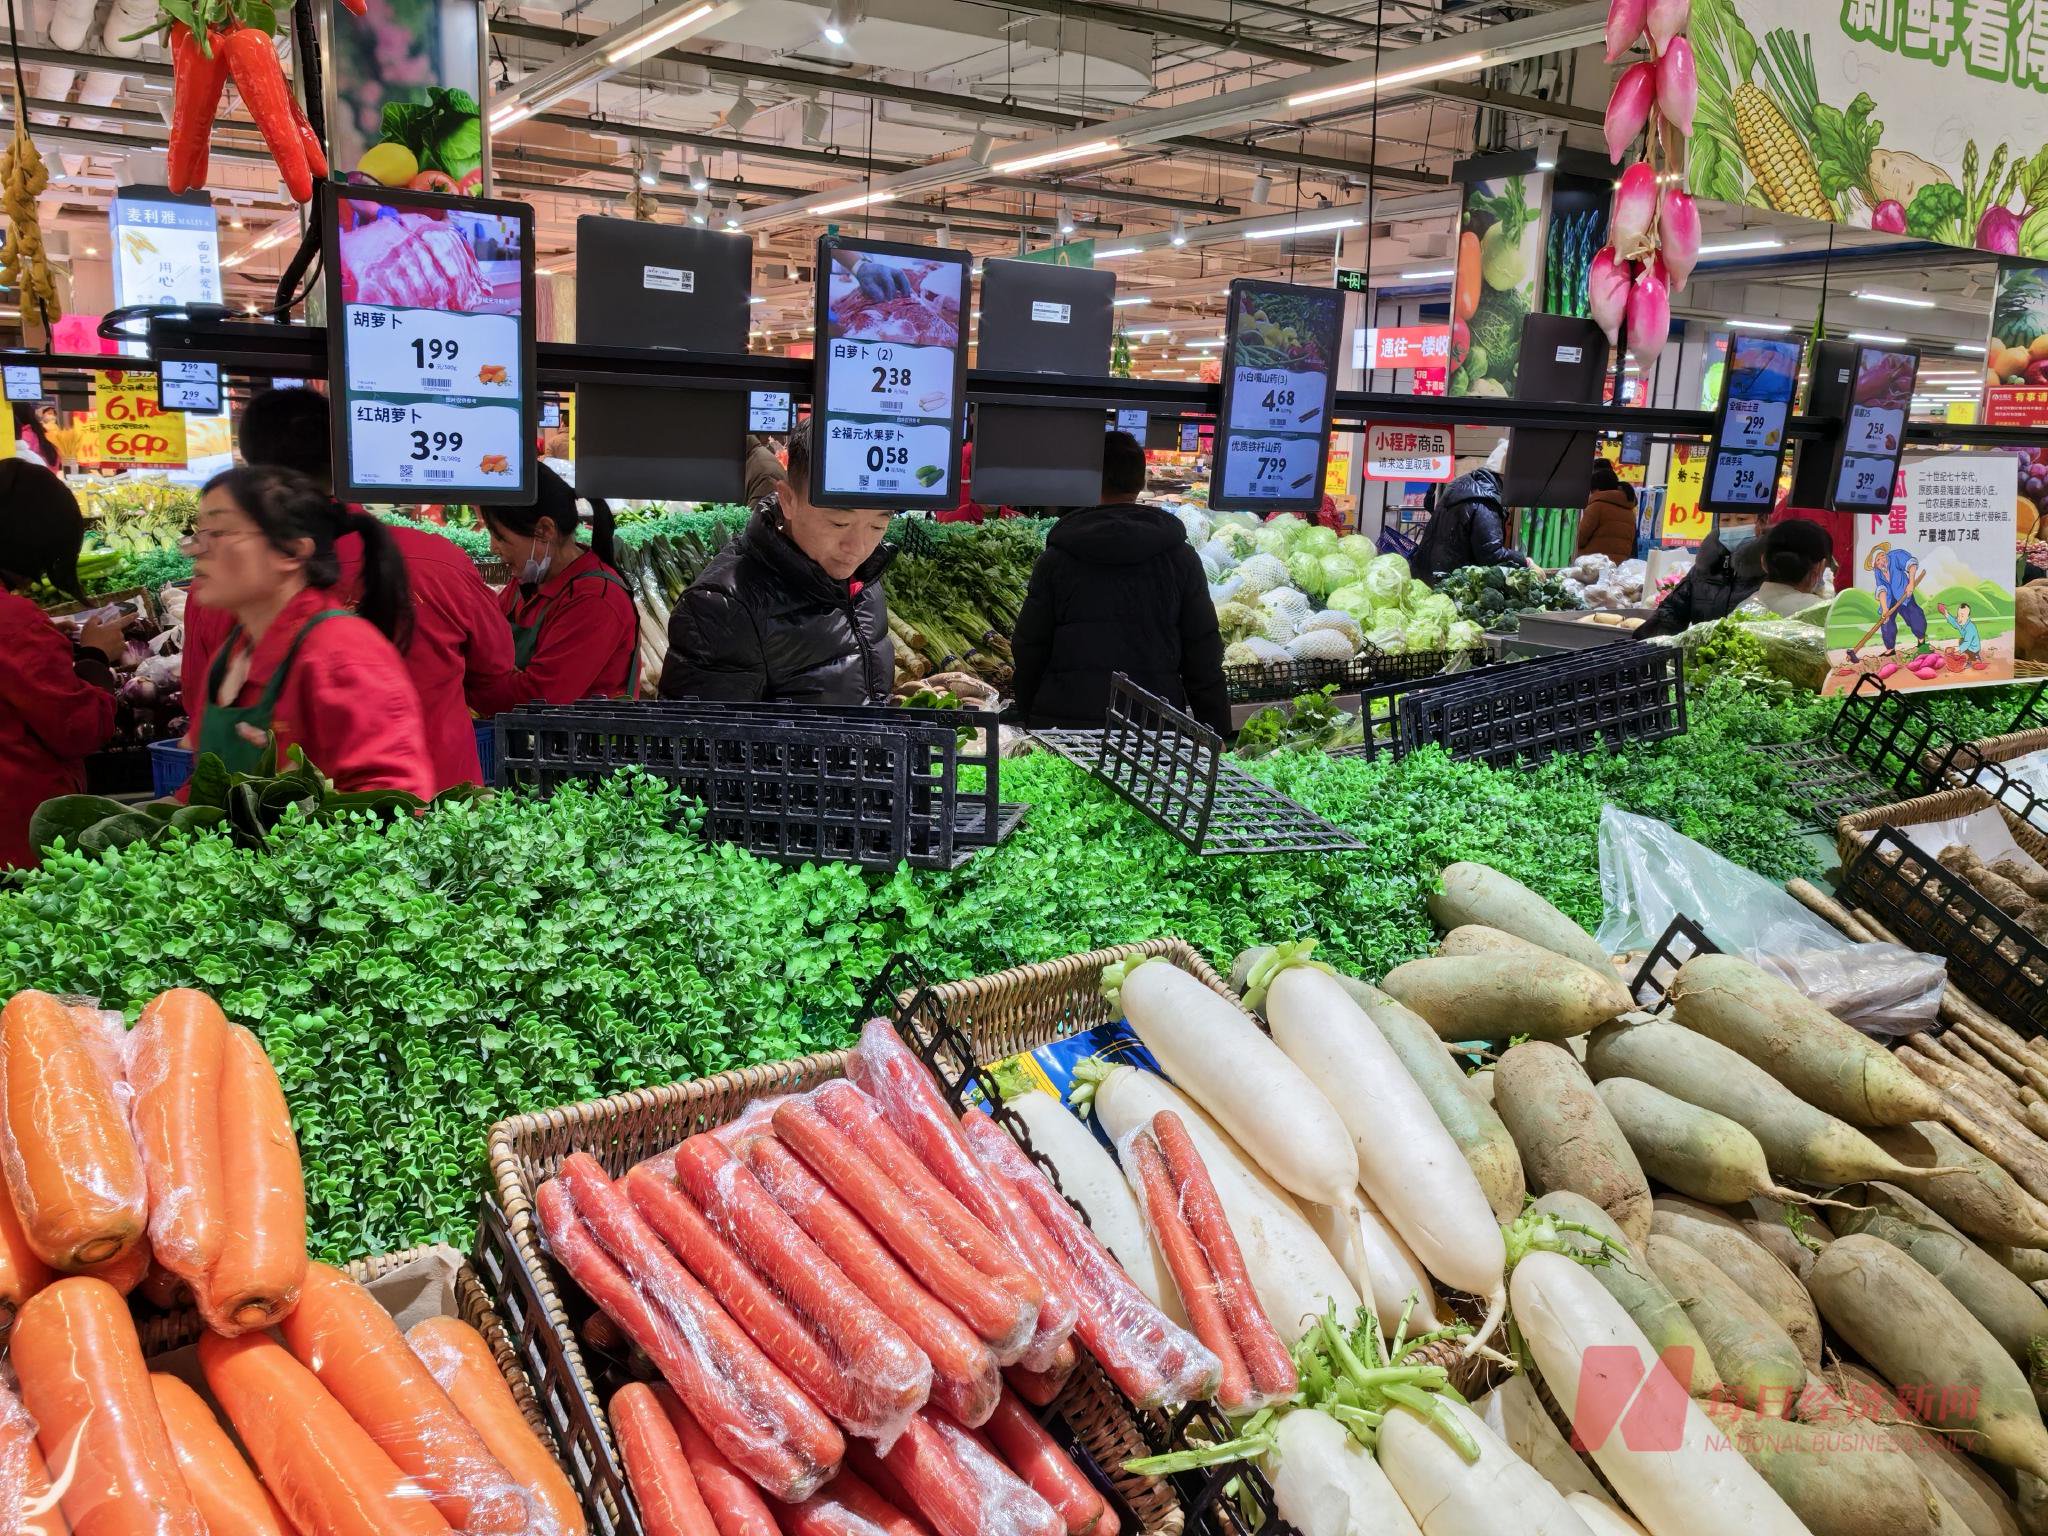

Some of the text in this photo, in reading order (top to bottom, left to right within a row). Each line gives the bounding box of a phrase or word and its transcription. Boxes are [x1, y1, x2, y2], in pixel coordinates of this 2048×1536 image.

[127, 207, 177, 225] 麦利雅
[353, 310, 403, 330] 胡萝卜
[411, 338, 459, 369] 1.99
[1381, 335, 1449, 358] 通往一楼收
[871, 366, 912, 394] 2.38
[1261, 389, 1295, 412] 4.68
[357, 406, 422, 425] 红胡萝卜
[1743, 415, 1765, 435] 2.99
[832, 426, 905, 442] 全福元水果萝卜
[1865, 422, 1885, 440] 2.58
[410, 430, 463, 461] 3.99
[1376, 431, 1445, 454] 小程序商品
[867, 445, 909, 472] 0.58
[1256, 457, 1287, 480] 7.99
[1379, 456, 1431, 470] 请来这里取哦
[1733, 469, 1755, 488] 3.58
[1855, 472, 1875, 490] 3.99
[1918, 528, 1980, 543] 产量增加了3成
